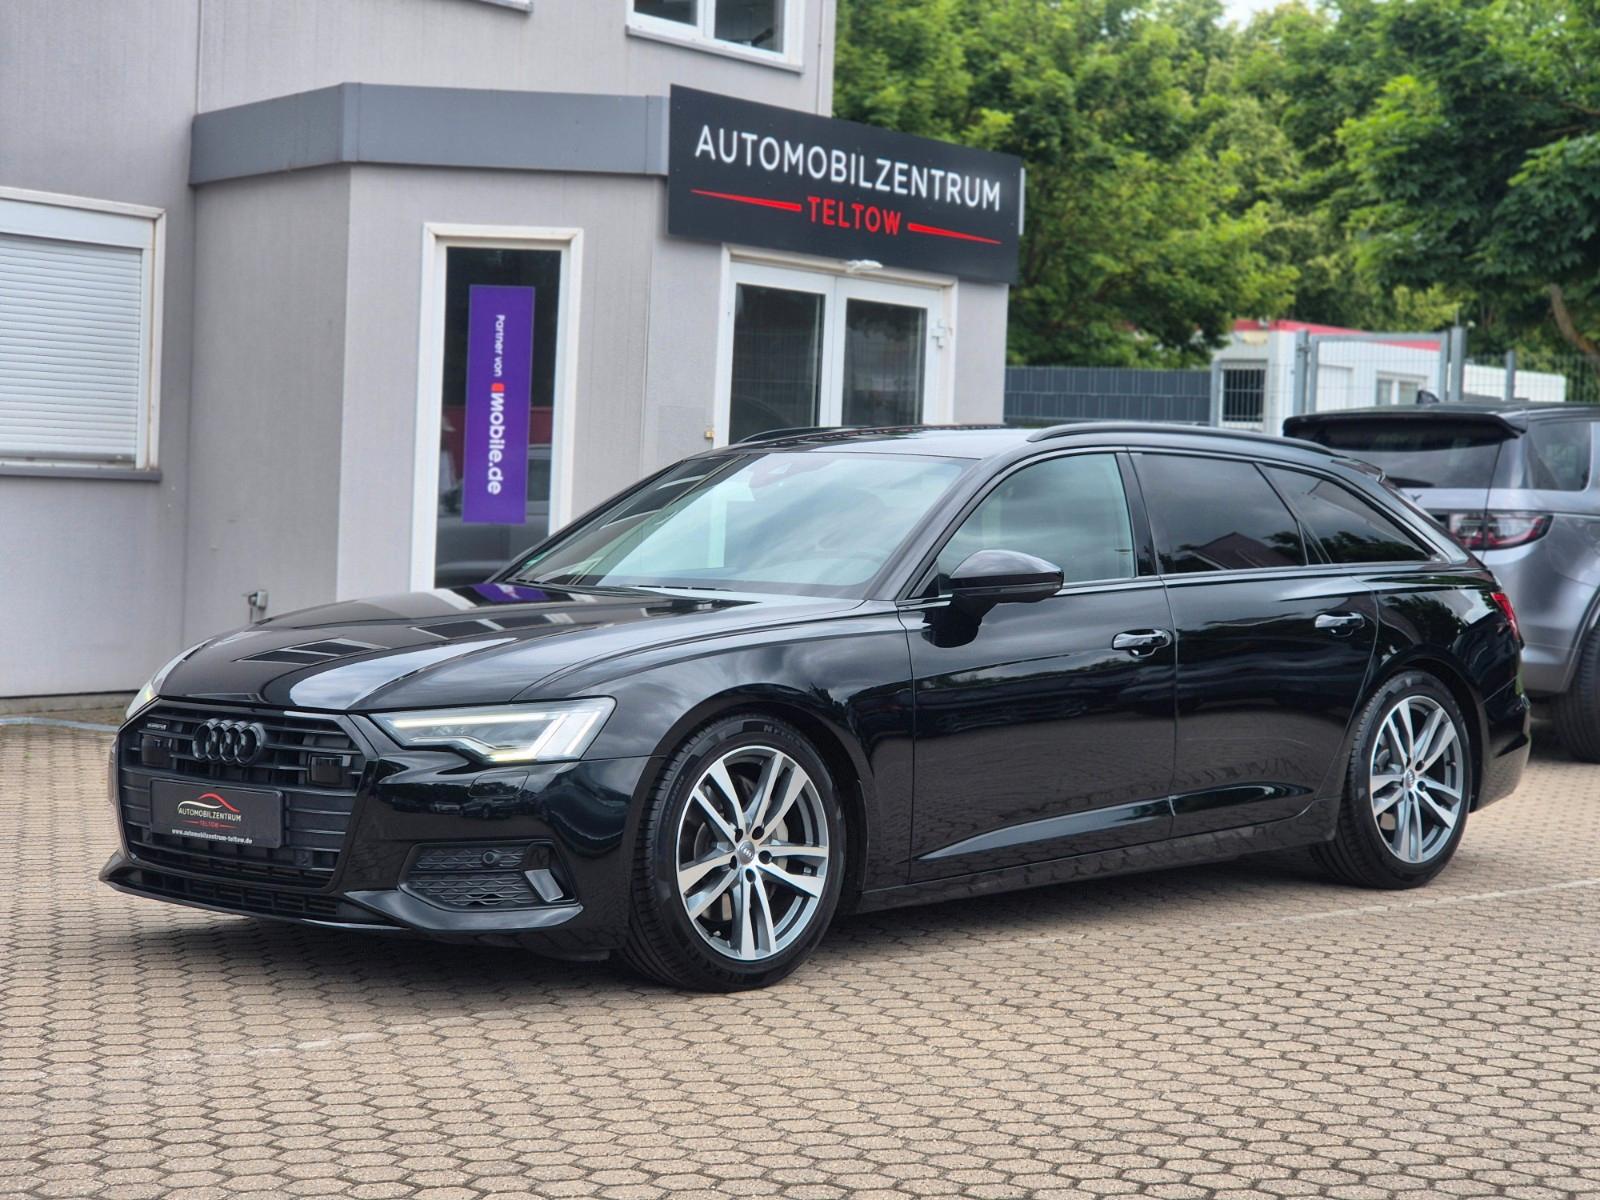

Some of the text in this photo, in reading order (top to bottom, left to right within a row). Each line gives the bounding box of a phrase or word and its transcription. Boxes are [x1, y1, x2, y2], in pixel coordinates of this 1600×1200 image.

[695, 124, 1001, 212] AUTOMOBILZENTRUM
[807, 195, 902, 236] TELTOW
[487, 314, 505, 495] Partner von mobile.de
[178, 807, 242, 822] AUTOMOBILZENTRUM
